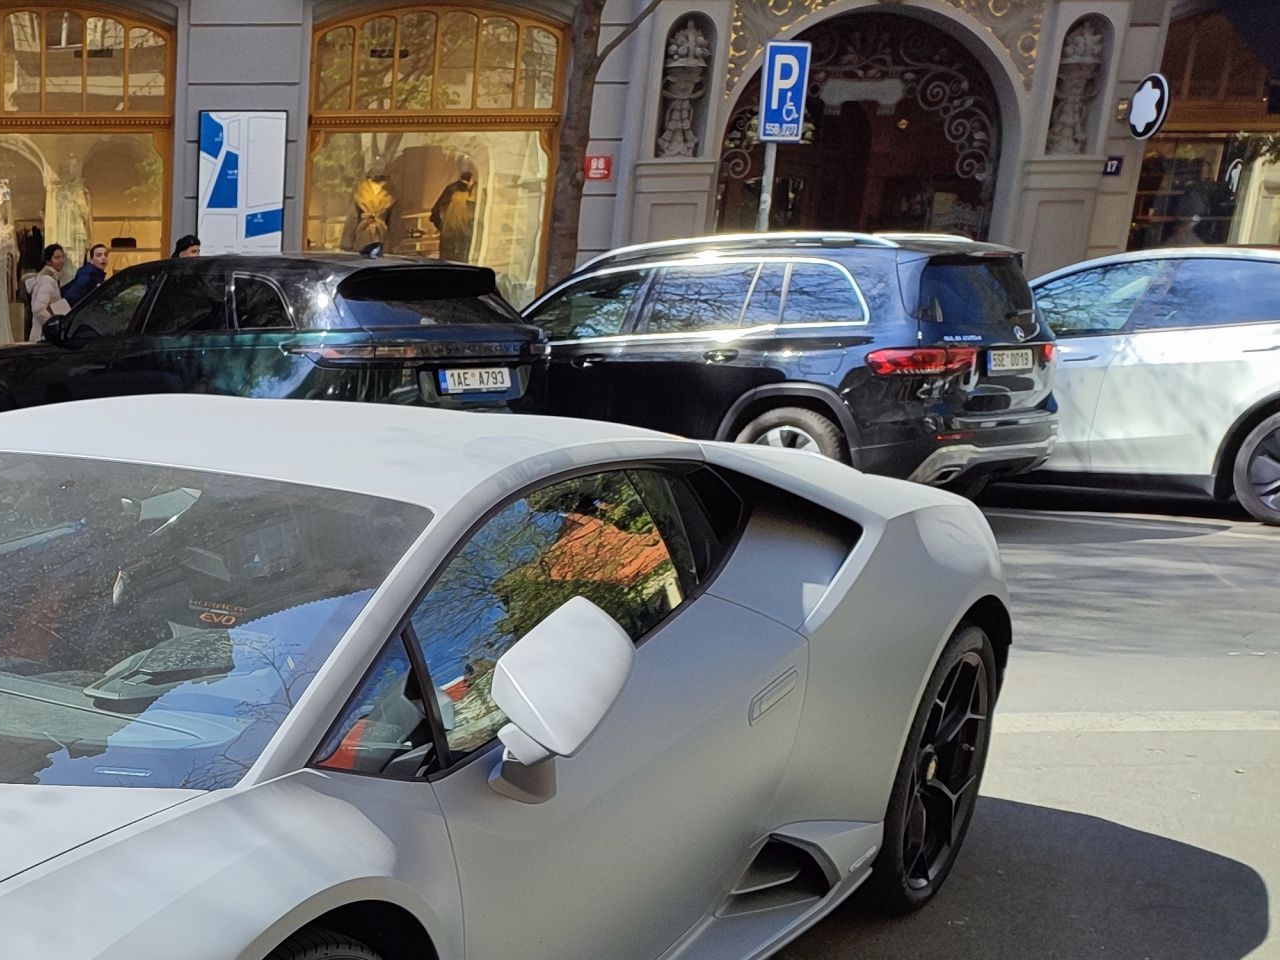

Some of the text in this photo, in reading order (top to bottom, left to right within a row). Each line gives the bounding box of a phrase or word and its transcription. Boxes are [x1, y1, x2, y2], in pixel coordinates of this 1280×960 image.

[771, 54, 800, 110] P
[450, 370, 505, 387] 1AE A793
